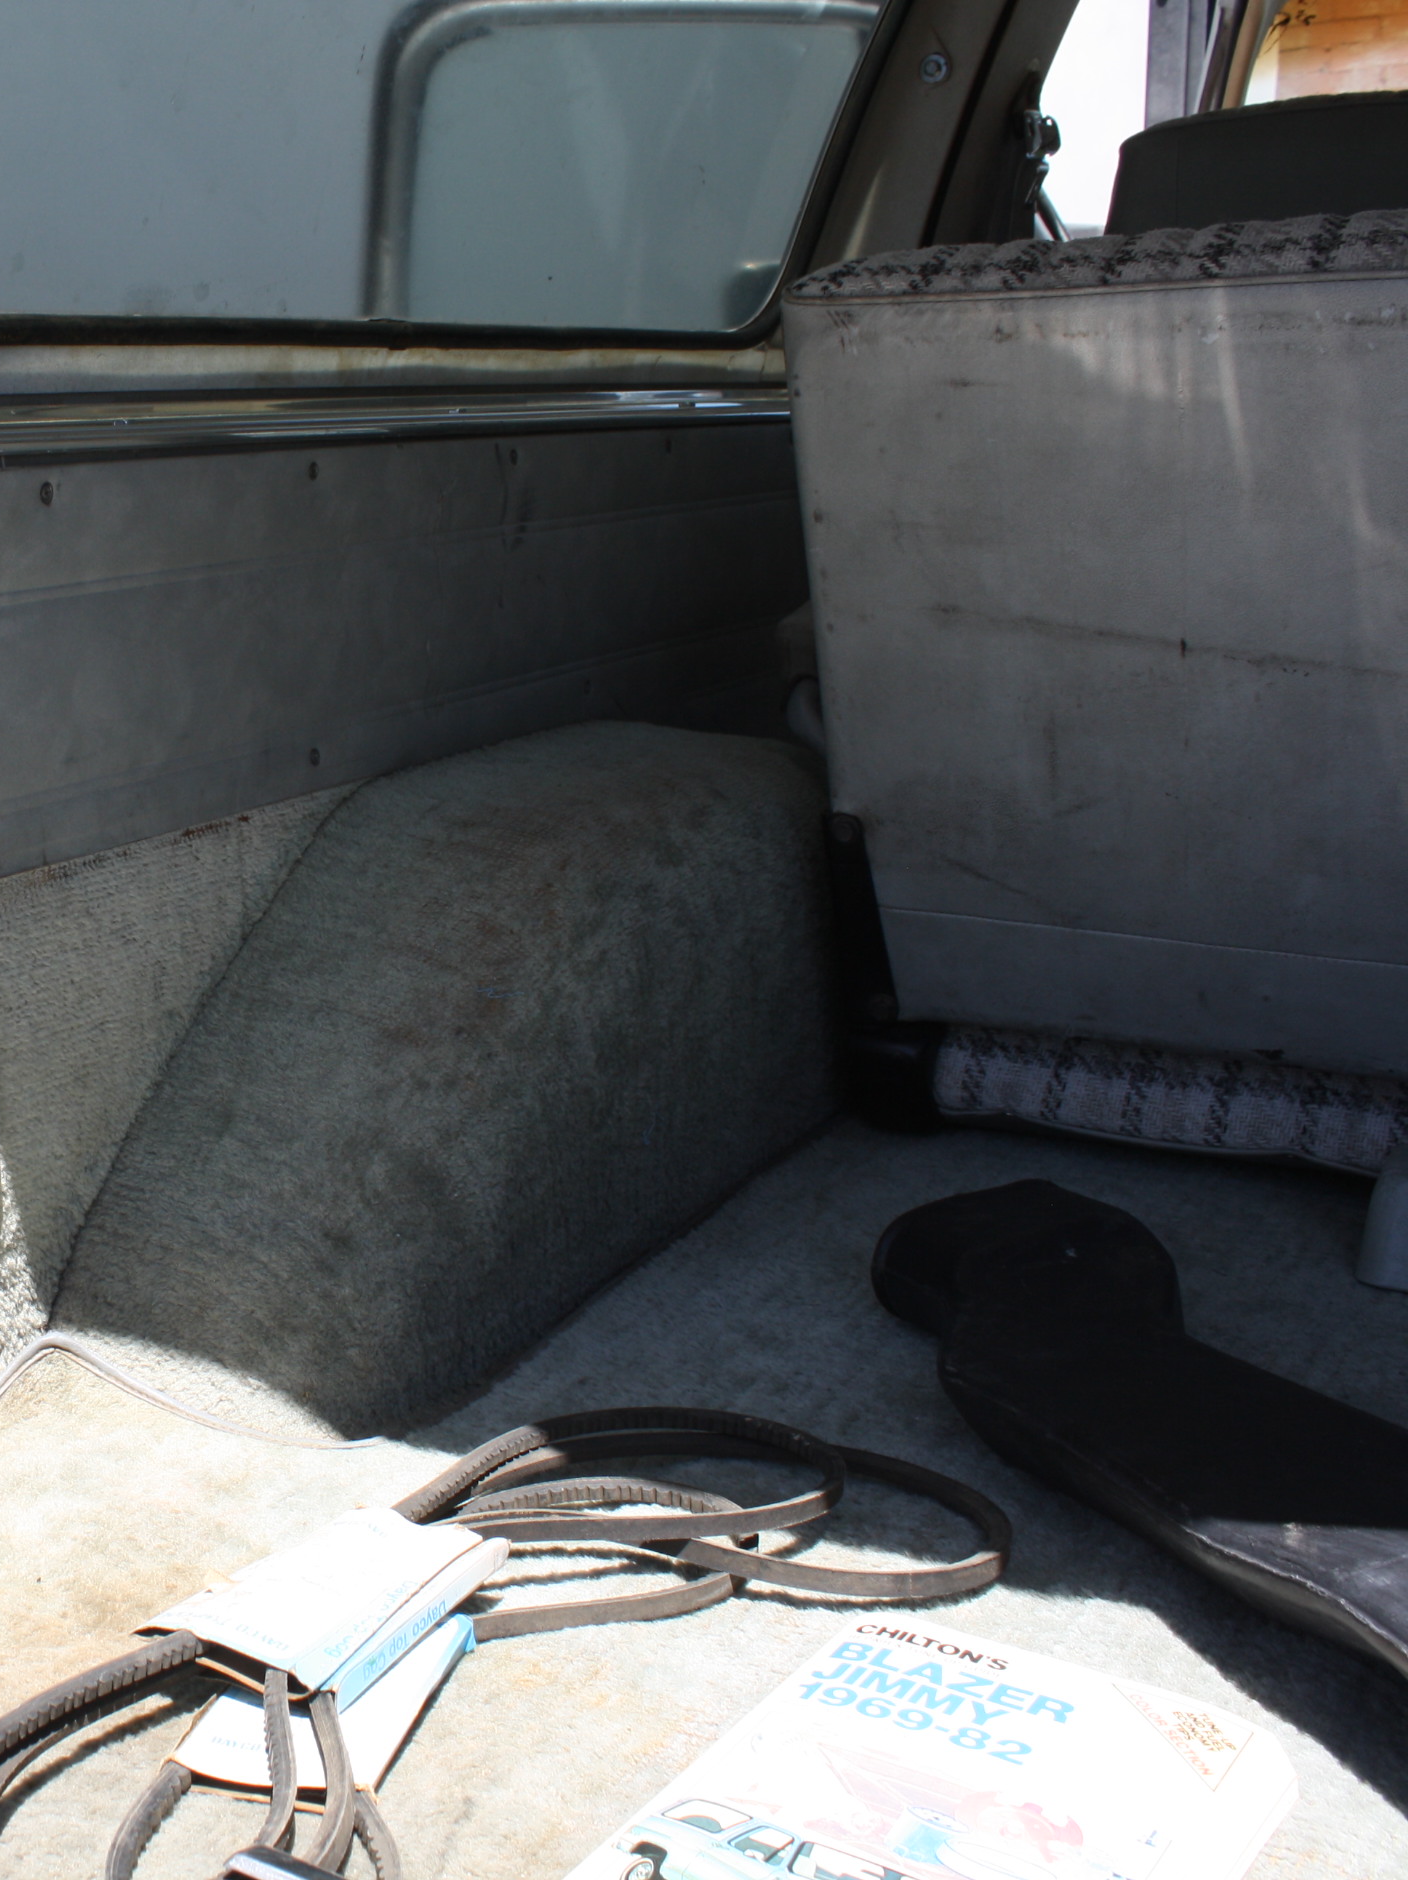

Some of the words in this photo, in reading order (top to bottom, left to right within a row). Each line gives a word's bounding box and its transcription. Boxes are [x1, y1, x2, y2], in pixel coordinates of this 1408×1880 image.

[389, 1633, 410, 1657] Top
[412, 1599, 447, 1637] Dayco
[363, 1649, 386, 1680] Cog
[855, 1624, 1010, 1671] CHILTON'S
[810, 1662, 1011, 1726] JIMMY
[829, 1641, 1075, 1724] BLAZER
[799, 1682, 1033, 1766] 1969-82
[1130, 1694, 1168, 1726] COLOR
[1164, 1730, 1214, 1775] SECTION
